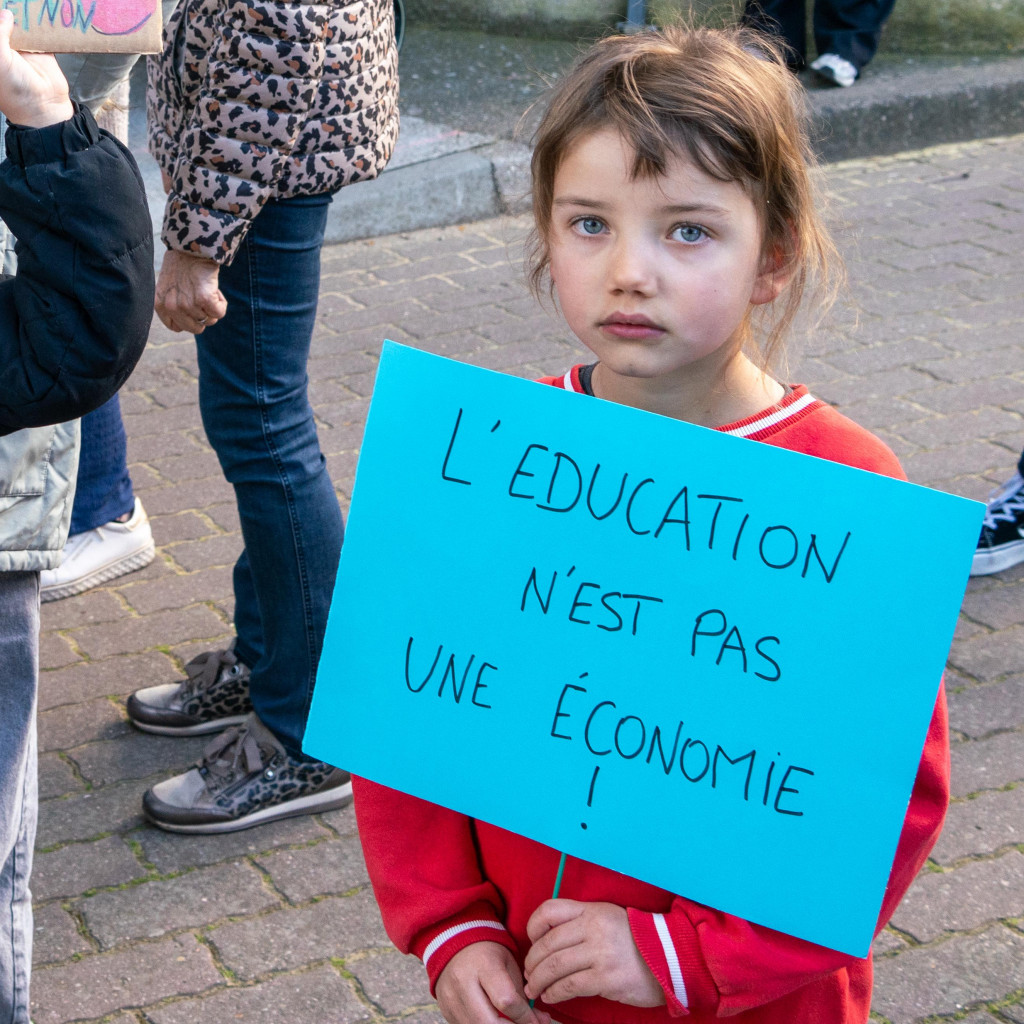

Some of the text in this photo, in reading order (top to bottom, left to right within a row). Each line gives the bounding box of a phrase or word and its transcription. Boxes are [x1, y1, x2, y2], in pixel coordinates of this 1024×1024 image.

[441, 408, 851, 584] L'EDUCATION
[521, 565, 782, 682] N'EST PAS
[404, 636, 815, 817] UNE ÉCONOMIE
[579, 766, 601, 831] !
